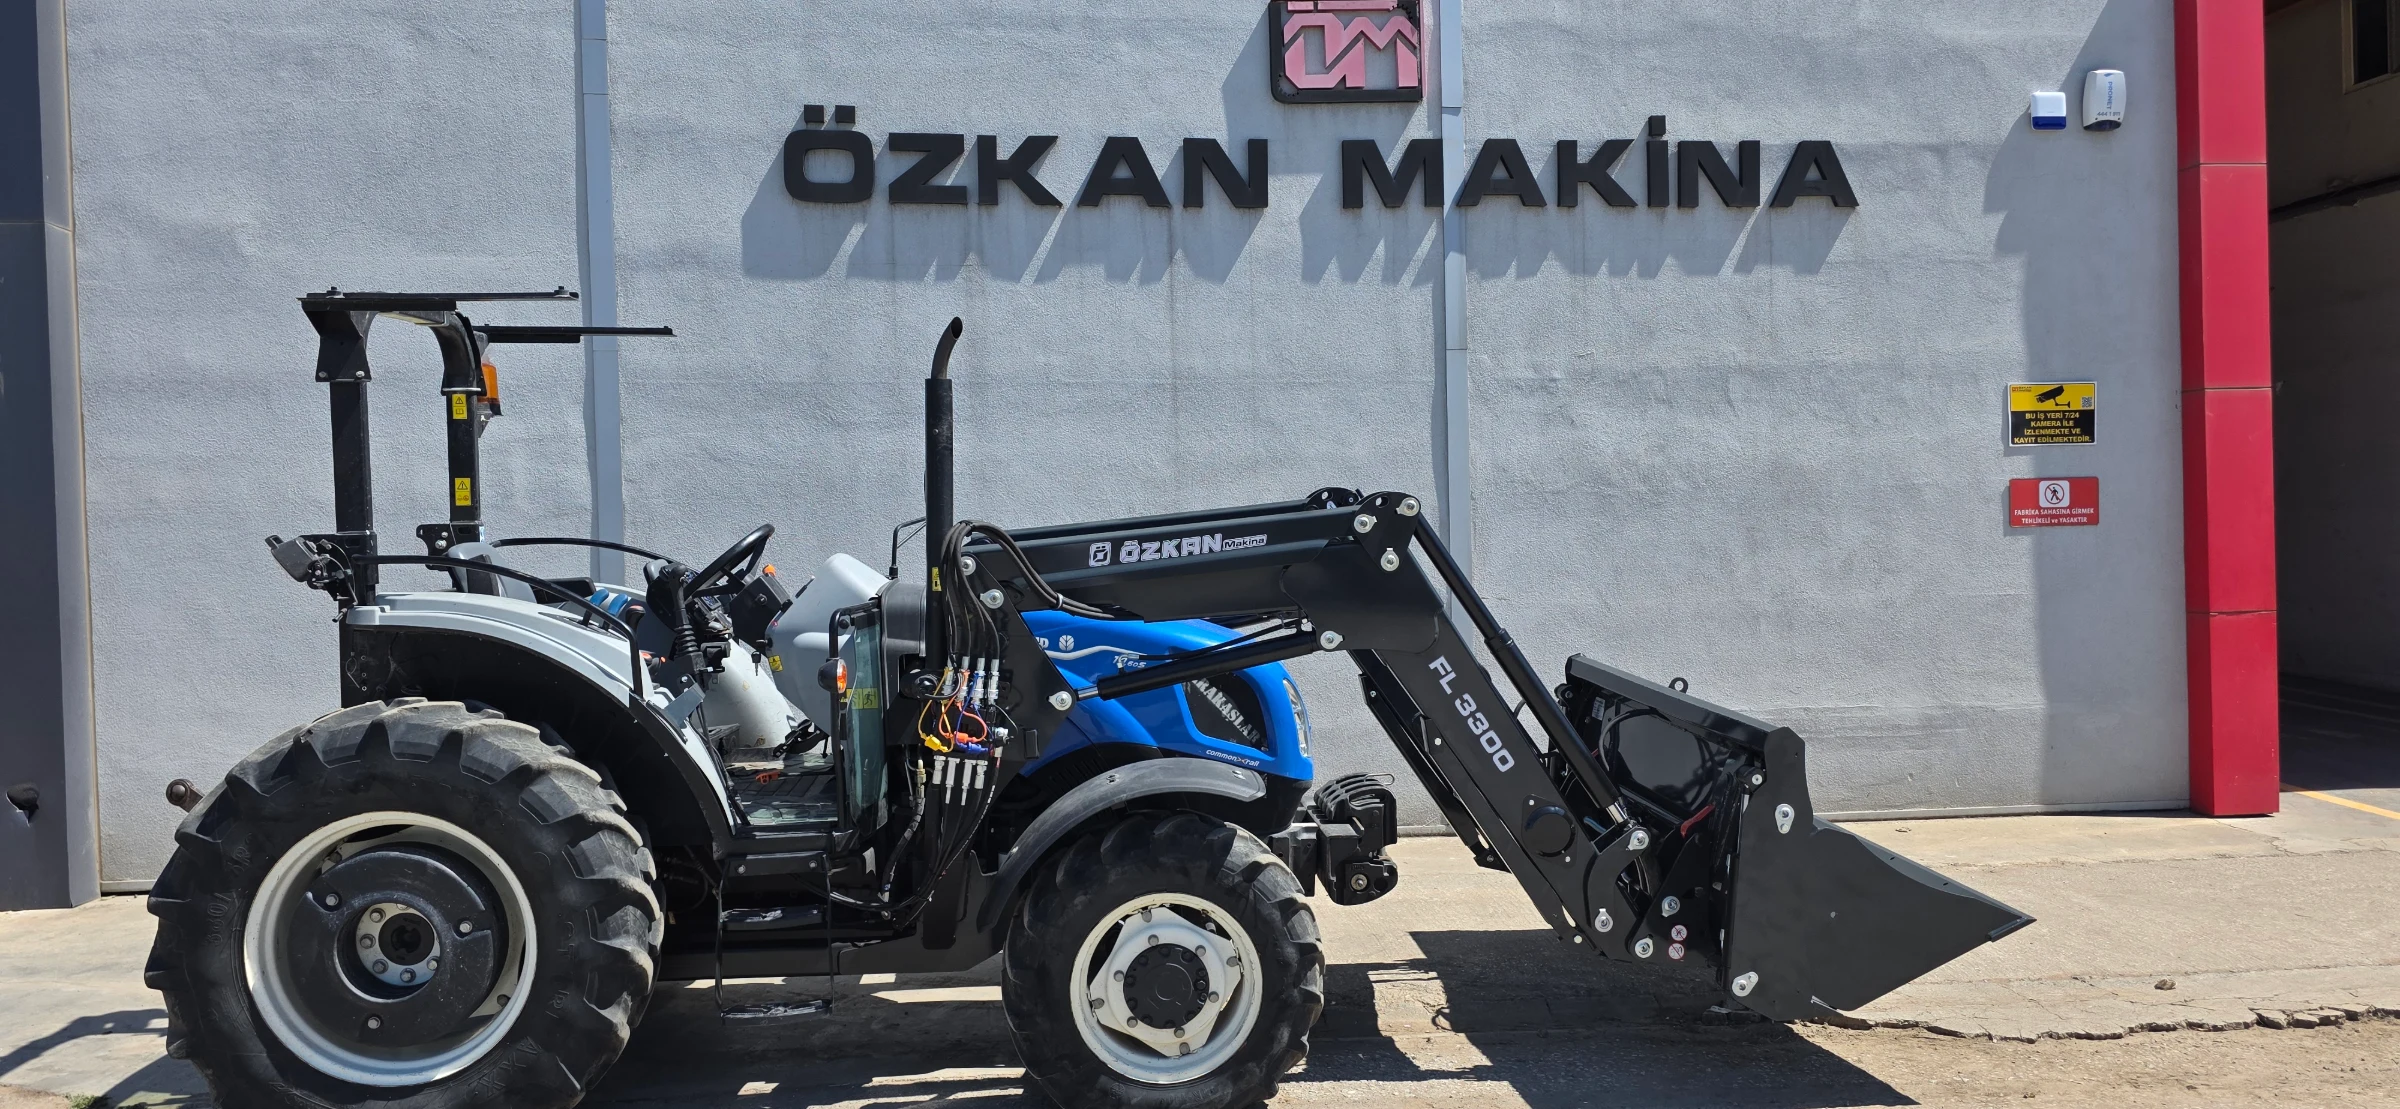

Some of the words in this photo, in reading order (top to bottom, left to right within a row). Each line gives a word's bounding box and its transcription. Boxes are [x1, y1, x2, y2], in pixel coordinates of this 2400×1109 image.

[783, 104, 1269, 208] ÖZKAN
[1341, 114, 1860, 209] MAKİNA
[2037, 411, 2045, 420] İŞ
[2046, 411, 2063, 419] YERİ
[2062, 419, 2075, 427] İLE
[2024, 428, 2070, 436] İZLENMEKTE
[2013, 436, 2036, 444] KAYIT
[2037, 434, 2092, 443] EDİLMEKTEDİR.
[2014, 508, 2040, 516] FABRİKA
[2021, 516, 2051, 524] TEHLİKELİ
[1119, 533, 1223, 564] ÖZKAN
[1223, 535, 1267, 549] Makina
[1191, 678, 1261, 743] RAKAŞLAR
[1428, 655, 1457, 695] FL
[1454, 693, 1515, 773] 3300
